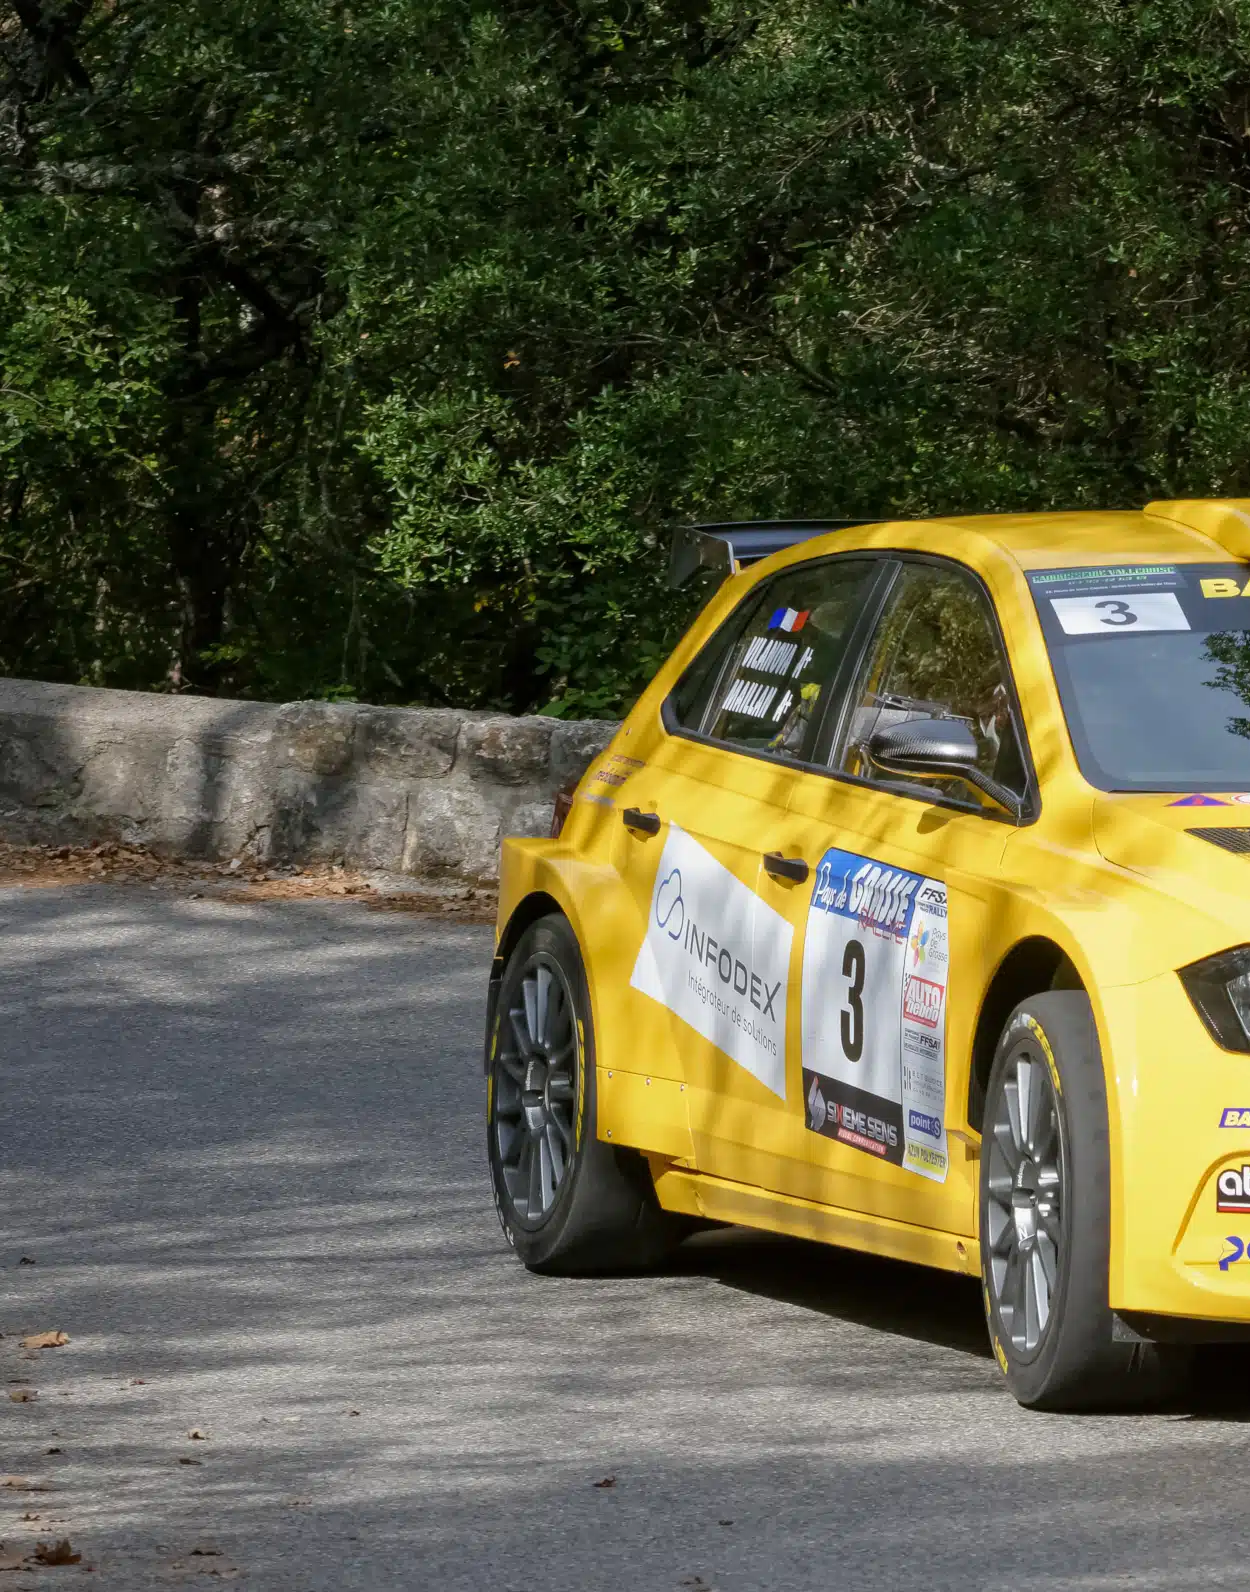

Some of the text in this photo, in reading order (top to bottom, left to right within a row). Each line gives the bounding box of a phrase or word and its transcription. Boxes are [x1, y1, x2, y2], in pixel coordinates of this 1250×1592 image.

[1095, 600, 1138, 626] 3
[813, 862, 837, 914] Pays
[684, 919, 781, 1023] INFODEX
[688, 970, 778, 1057] Intégrateur de solutions
[841, 939, 865, 1063] 3
[867, 1116, 898, 1147] SENS
[910, 1114, 930, 1131] point
